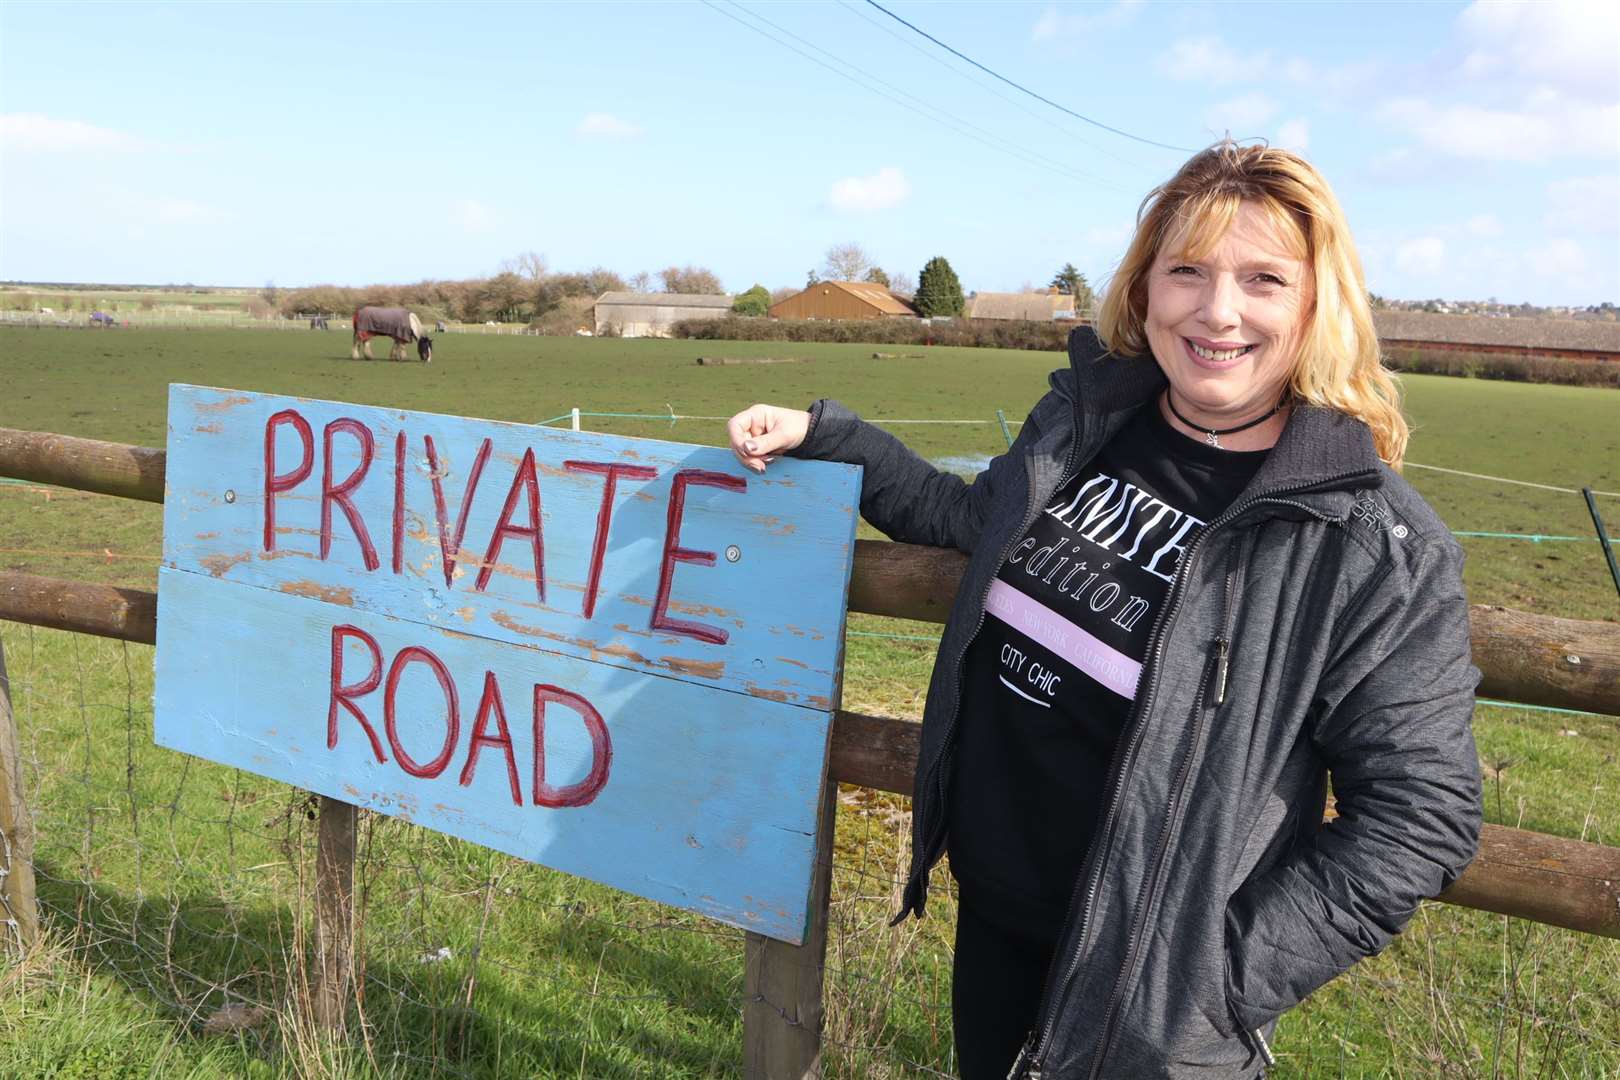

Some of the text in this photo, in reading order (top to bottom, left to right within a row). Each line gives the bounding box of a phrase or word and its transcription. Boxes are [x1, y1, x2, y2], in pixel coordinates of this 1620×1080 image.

[263, 408, 747, 645] PRIVATE
[1045, 472, 1207, 584] IMITE
[1009, 536, 1150, 632] edition
[327, 623, 613, 809] ROAD
[1000, 642, 1062, 697] CITY CHIC
